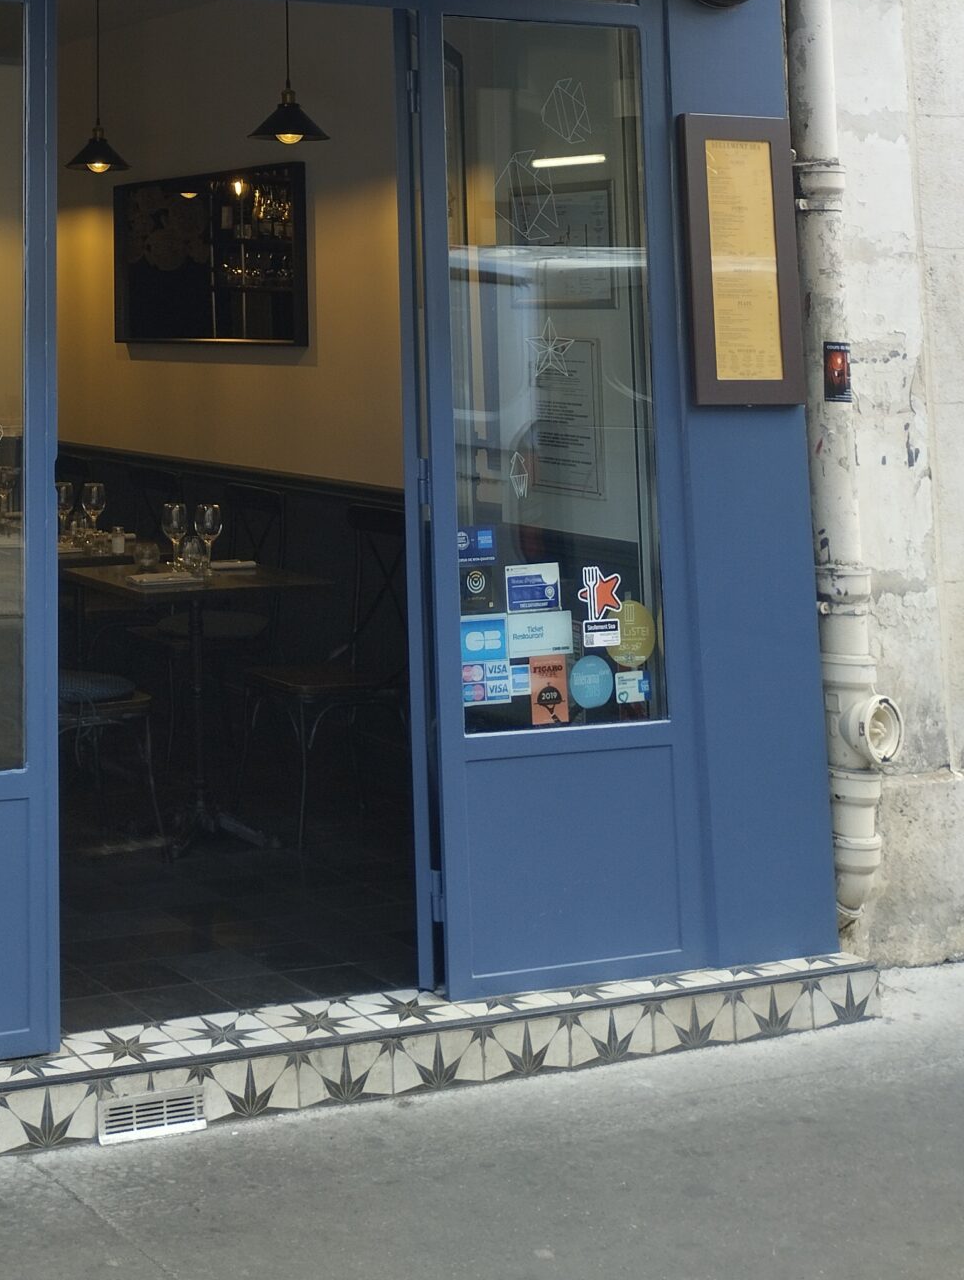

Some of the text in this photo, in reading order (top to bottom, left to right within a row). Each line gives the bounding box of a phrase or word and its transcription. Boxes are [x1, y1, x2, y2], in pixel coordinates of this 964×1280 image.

[488, 665, 507, 673] VISA
[533, 665, 563, 673] FIGARO
[489, 684, 508, 693] VISA
[541, 692, 558, 700] 2019
